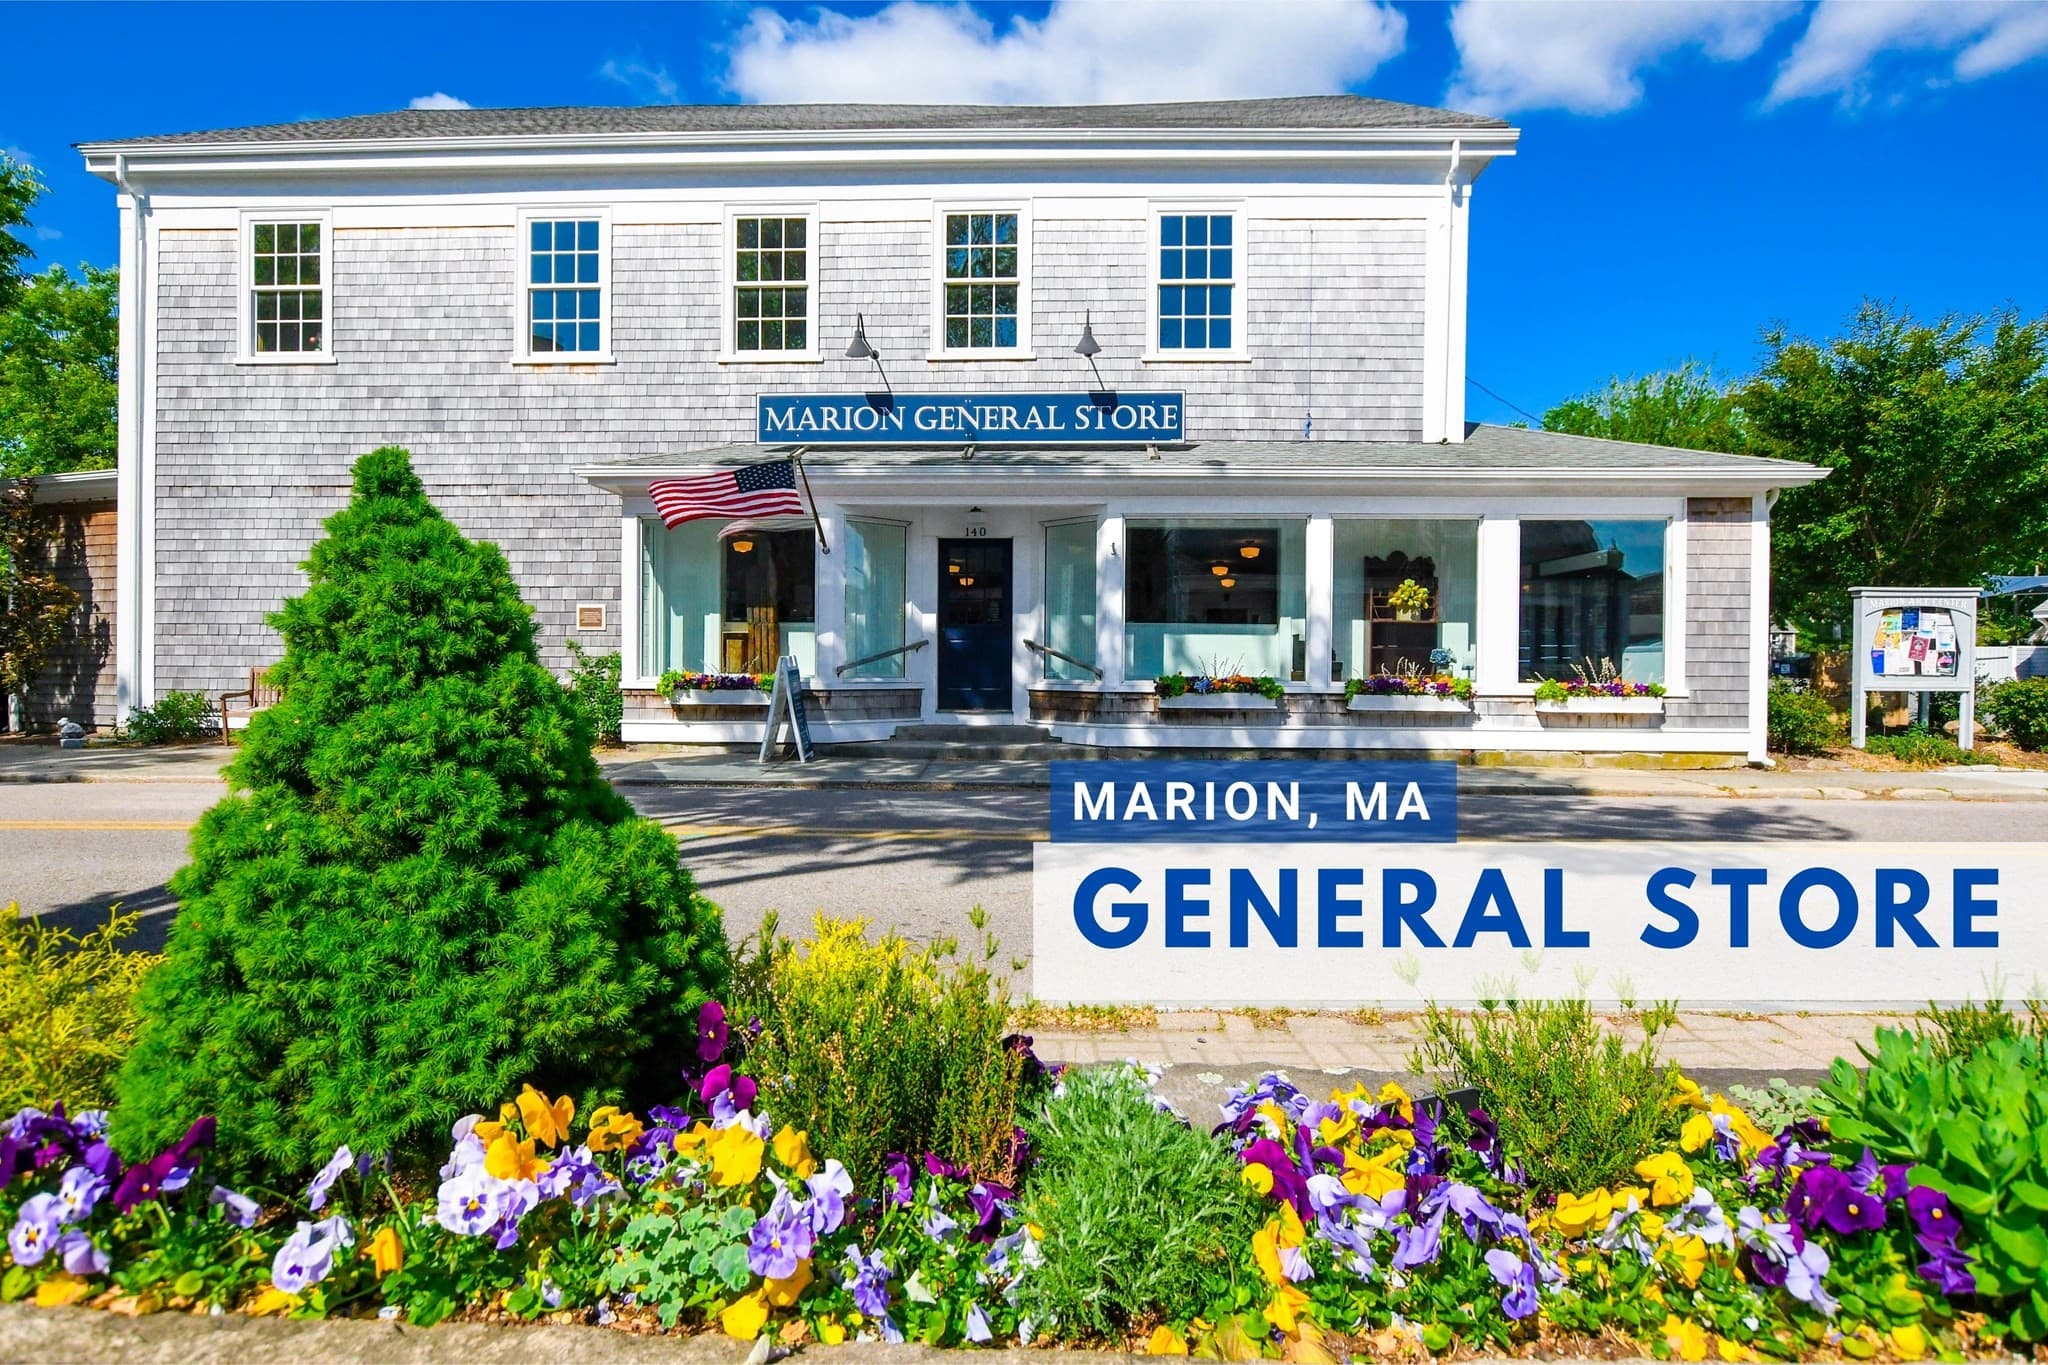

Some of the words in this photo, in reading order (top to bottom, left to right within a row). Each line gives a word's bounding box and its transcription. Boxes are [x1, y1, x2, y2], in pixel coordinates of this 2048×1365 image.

[765, 405, 905, 431] MARION
[914, 405, 1065, 431] GENERAL
[1074, 405, 1178, 431] STORE
[965, 527, 986, 537] 140
